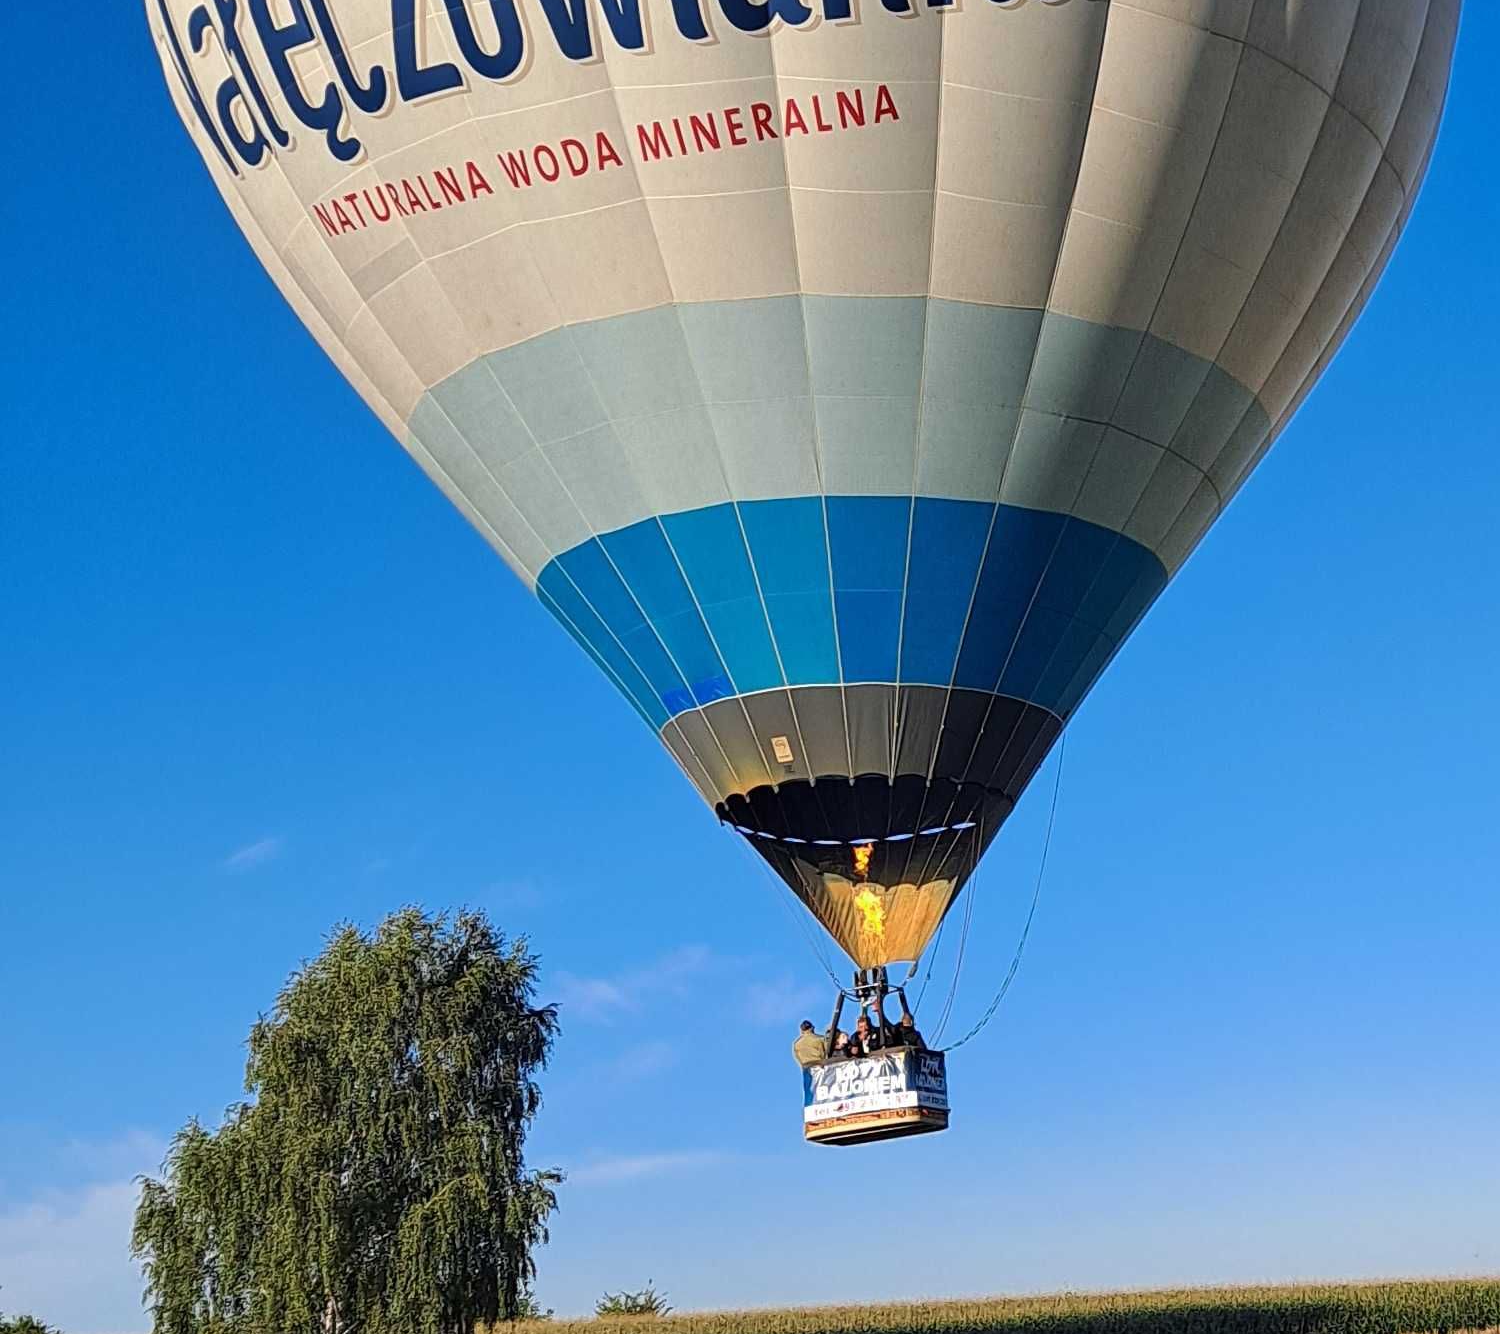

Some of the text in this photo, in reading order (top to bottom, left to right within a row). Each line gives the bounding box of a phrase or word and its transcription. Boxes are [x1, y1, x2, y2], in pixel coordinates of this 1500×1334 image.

[312, 85, 900, 237] NATURALNA WODA MINERALNA
[816, 1073, 906, 1101] BALONEM
